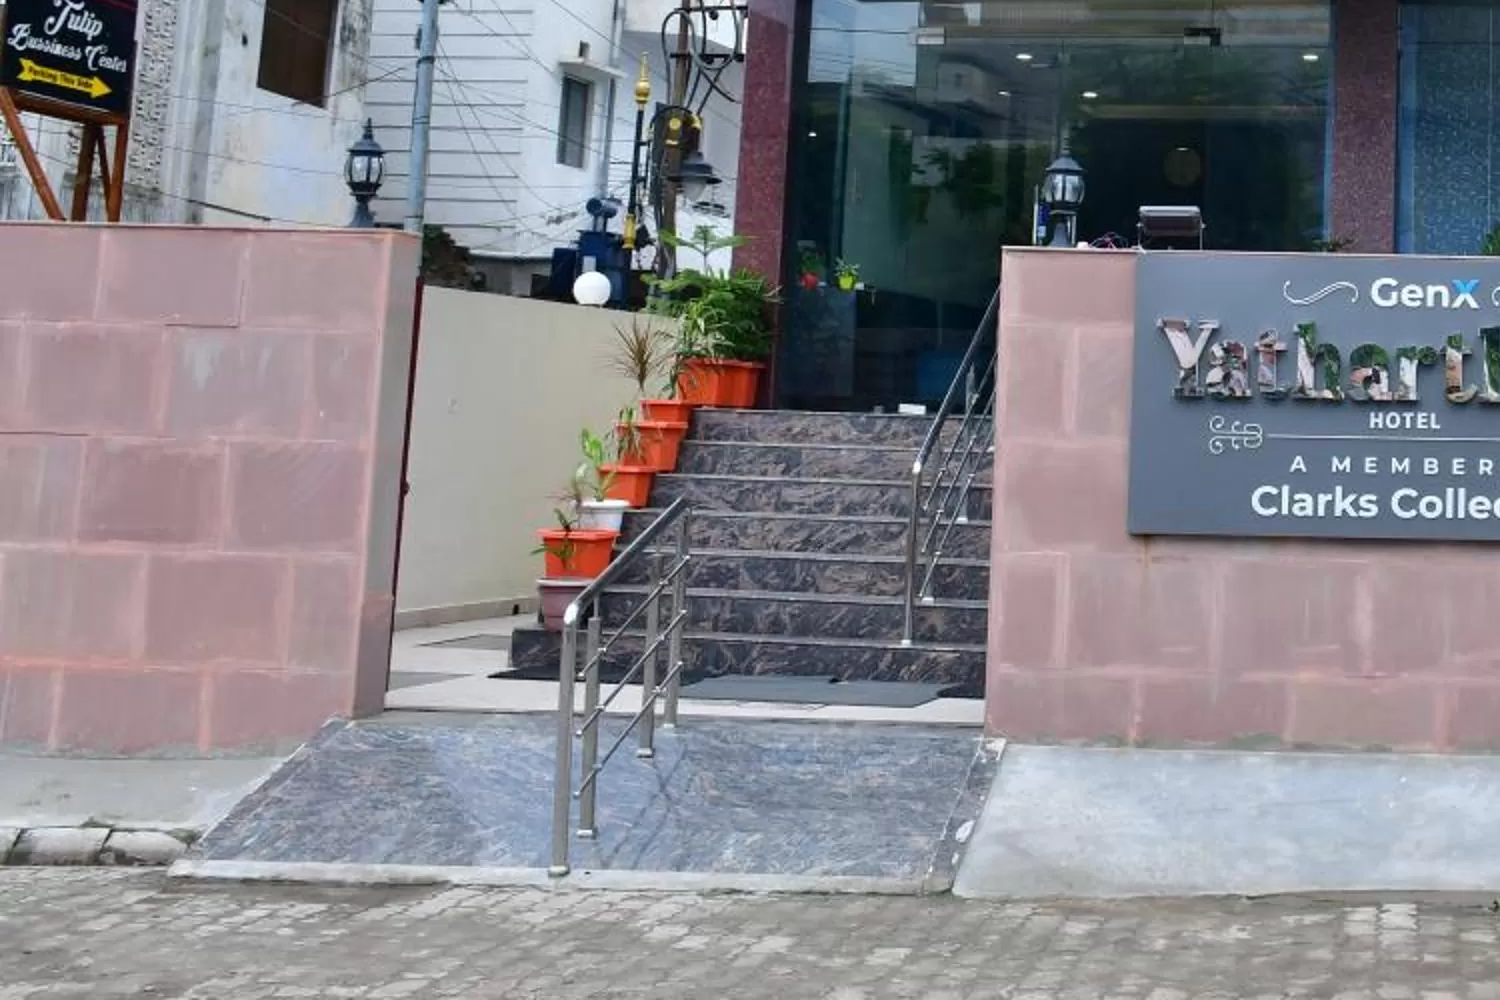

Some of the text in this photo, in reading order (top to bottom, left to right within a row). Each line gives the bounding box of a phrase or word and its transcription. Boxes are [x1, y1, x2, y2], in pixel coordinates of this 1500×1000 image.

[84, 44, 127, 73] Center
[1370, 277, 1480, 309] GenX
[1368, 411, 1441, 430] HOTEL
[1289, 455, 1307, 474] A
[1331, 456, 1494, 477] MEMBER
[1250, 485, 1378, 519] Clarks
